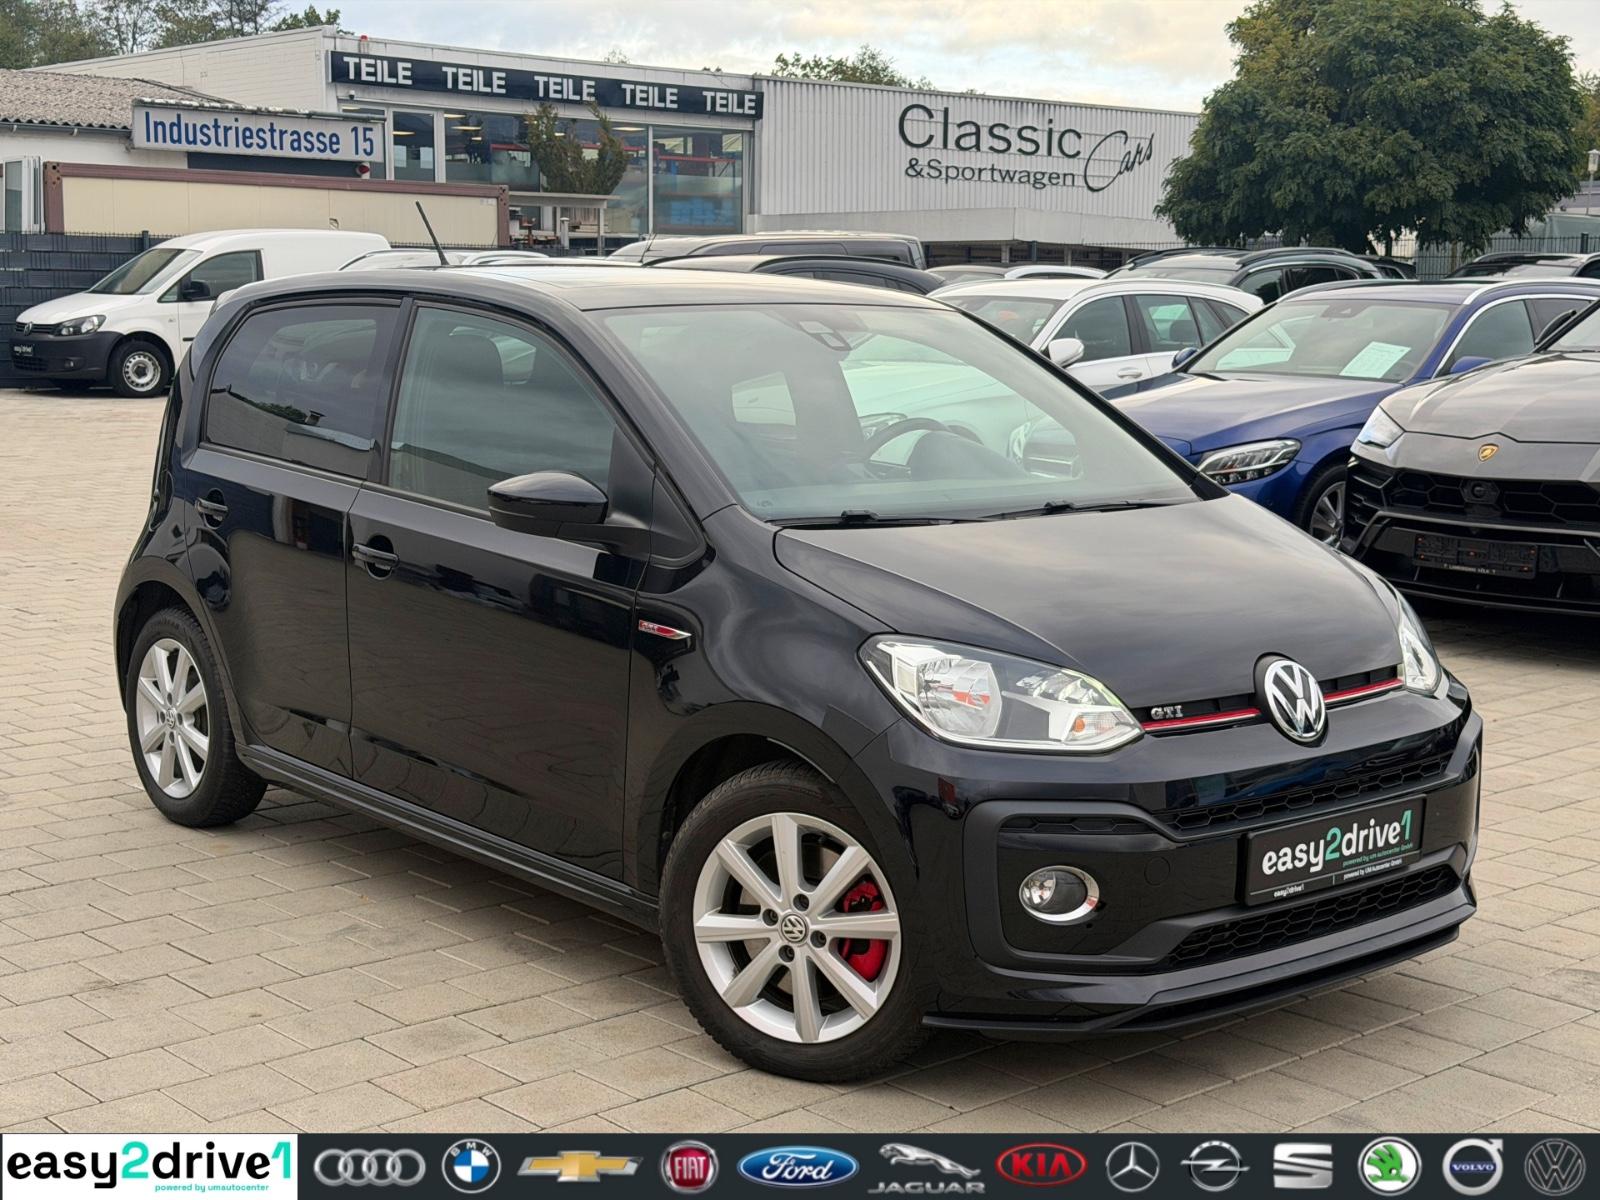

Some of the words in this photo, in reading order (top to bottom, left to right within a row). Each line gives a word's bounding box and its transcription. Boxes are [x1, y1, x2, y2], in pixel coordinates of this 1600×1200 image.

[343, 56, 413, 85] TEILE
[442, 66, 506, 94] TEILE
[534, 76, 596, 101] TEILE
[621, 83, 679, 109] TEILE
[702, 91, 756, 115] TEILE
[145, 111, 340, 154] Industriestrasse
[351, 126, 374, 156] 15
[899, 104, 1082, 159] Classic
[905, 157, 1075, 190] &Sportwagen
[1084, 130, 1155, 192] Cars
[1150, 705, 1183, 720] GTI
[1262, 810, 1412, 873] easy2drive1
